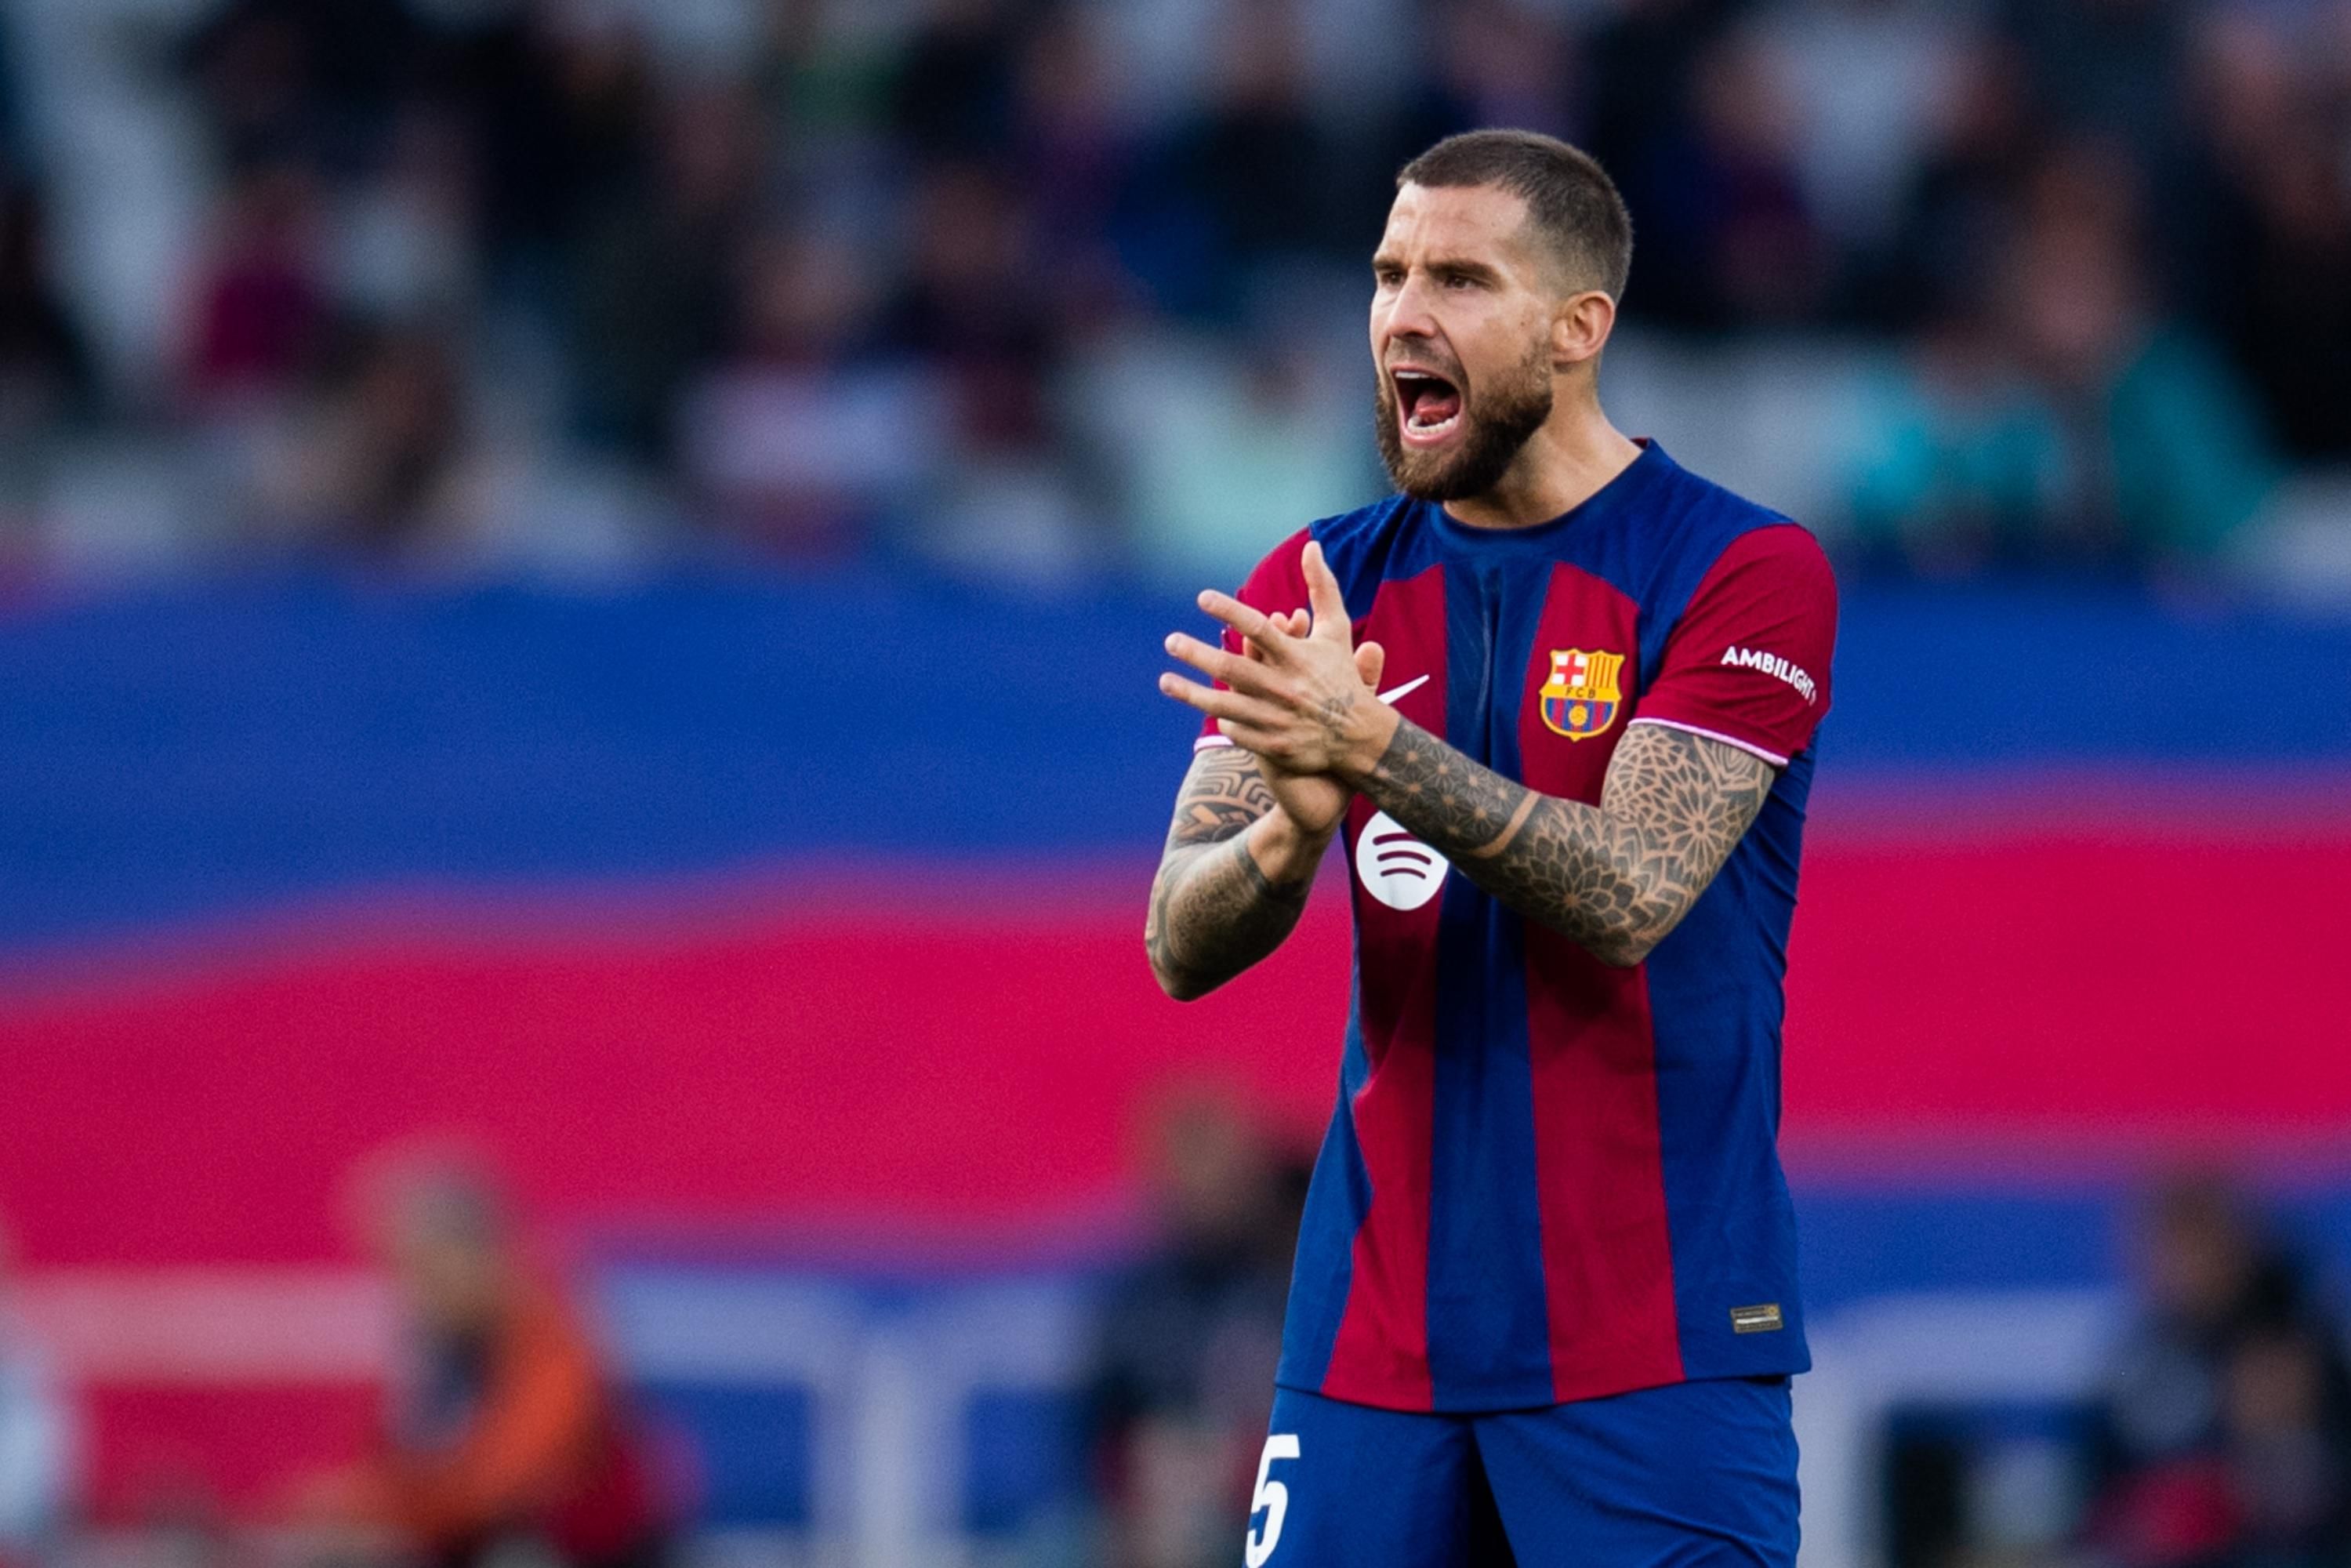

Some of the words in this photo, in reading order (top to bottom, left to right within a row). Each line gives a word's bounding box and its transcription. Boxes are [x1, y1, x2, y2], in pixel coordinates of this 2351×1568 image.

[1566, 687, 1596, 699] FCB
[1720, 645, 1816, 700] AMBILIGHT
[1245, 1433, 1301, 1568] 5
